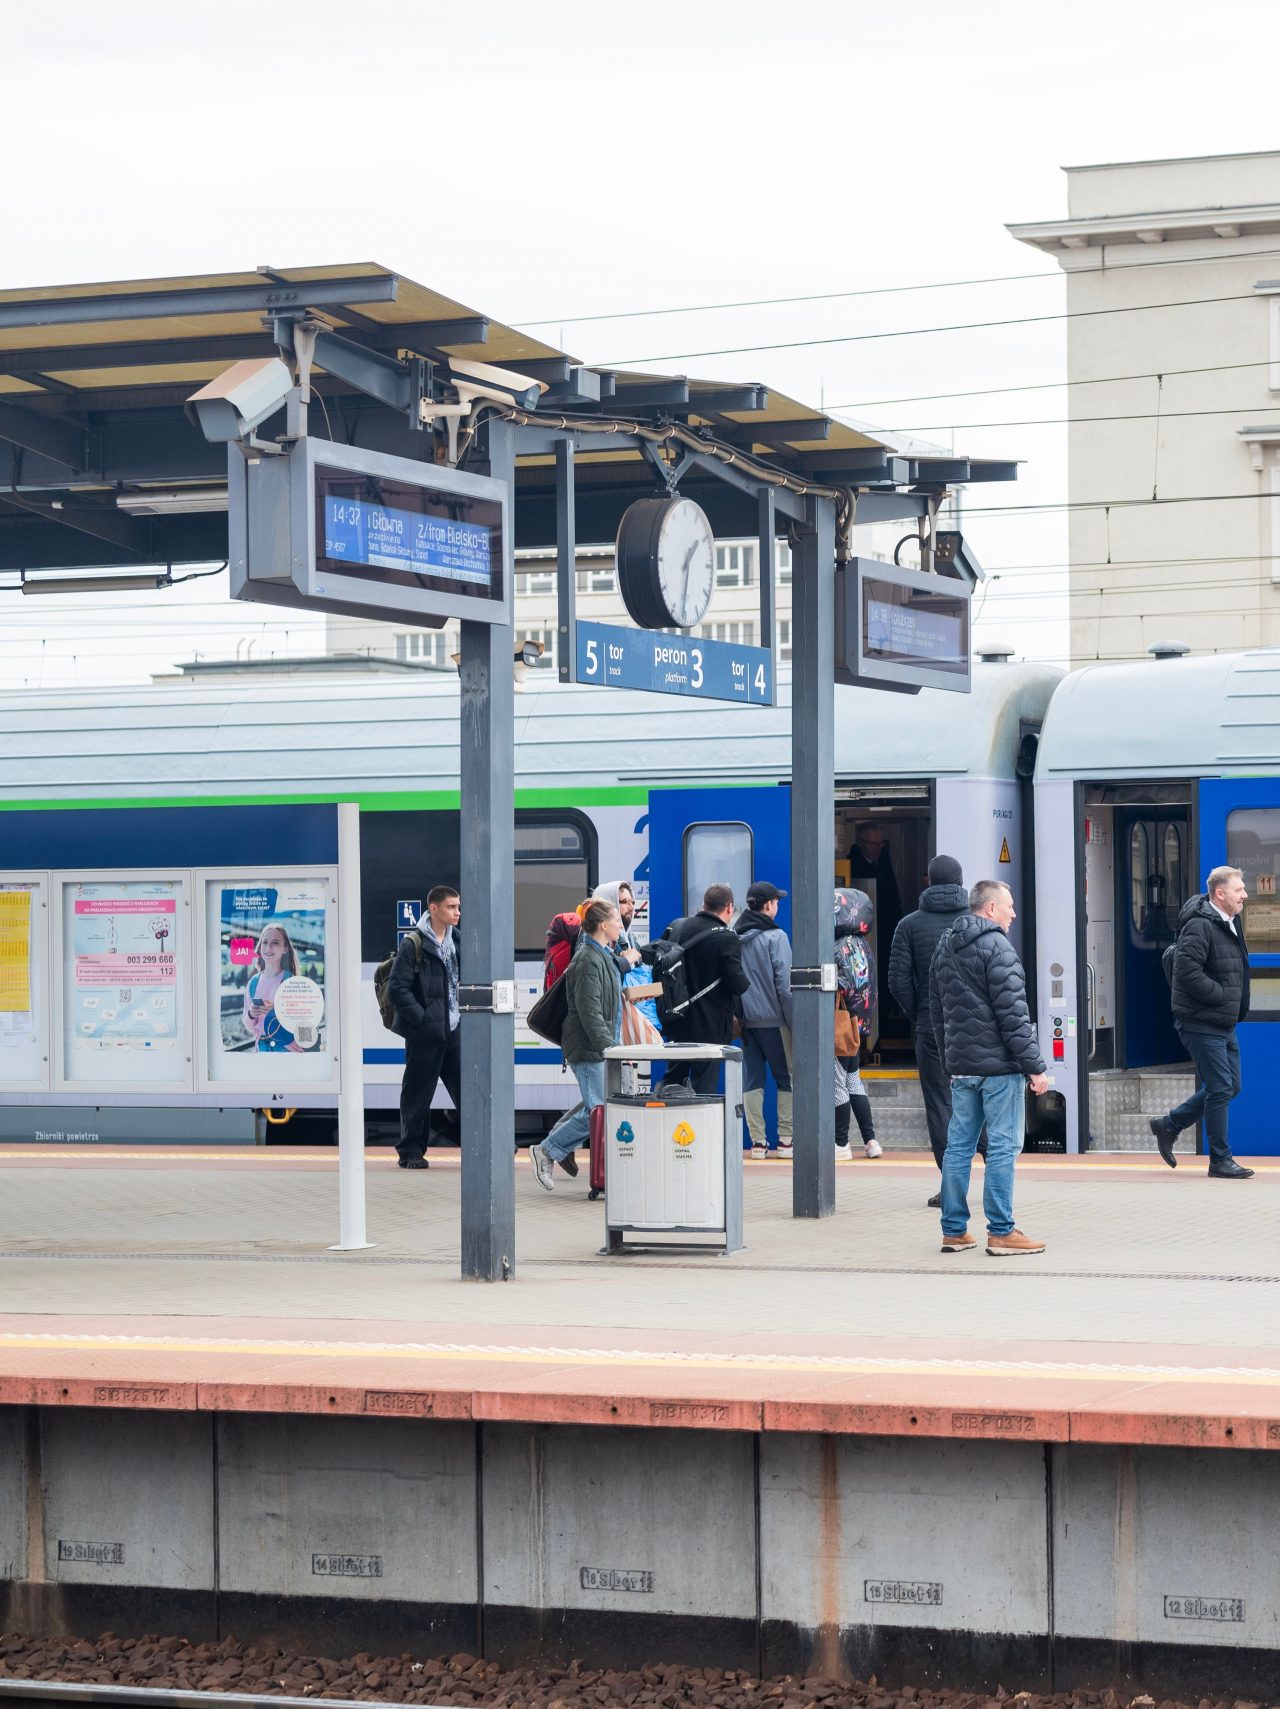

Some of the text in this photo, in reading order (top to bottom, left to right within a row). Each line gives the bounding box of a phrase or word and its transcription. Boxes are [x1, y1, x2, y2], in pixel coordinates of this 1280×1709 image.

[333, 504, 360, 526] 14:37
[372, 511, 403, 535] Główna
[586, 640, 624, 675] 5 tor
[609, 665, 622, 676] track
[654, 646, 704, 688] peron 3
[664, 671, 688, 684] platform
[731, 660, 766, 696] tor 4
[1261, 877, 1272, 891] 11
[236, 947, 249, 956] JA!
[143, 956, 157, 964] 299
[160, 967, 174, 975] 112
[35, 1131, 99, 1142] Zbiorniki powietrza
[316, 1558, 327, 1571] 14
[869, 1584, 941, 1602] 15 Sibet 12
[1168, 1599, 1243, 1618] 12 Sibet 12
